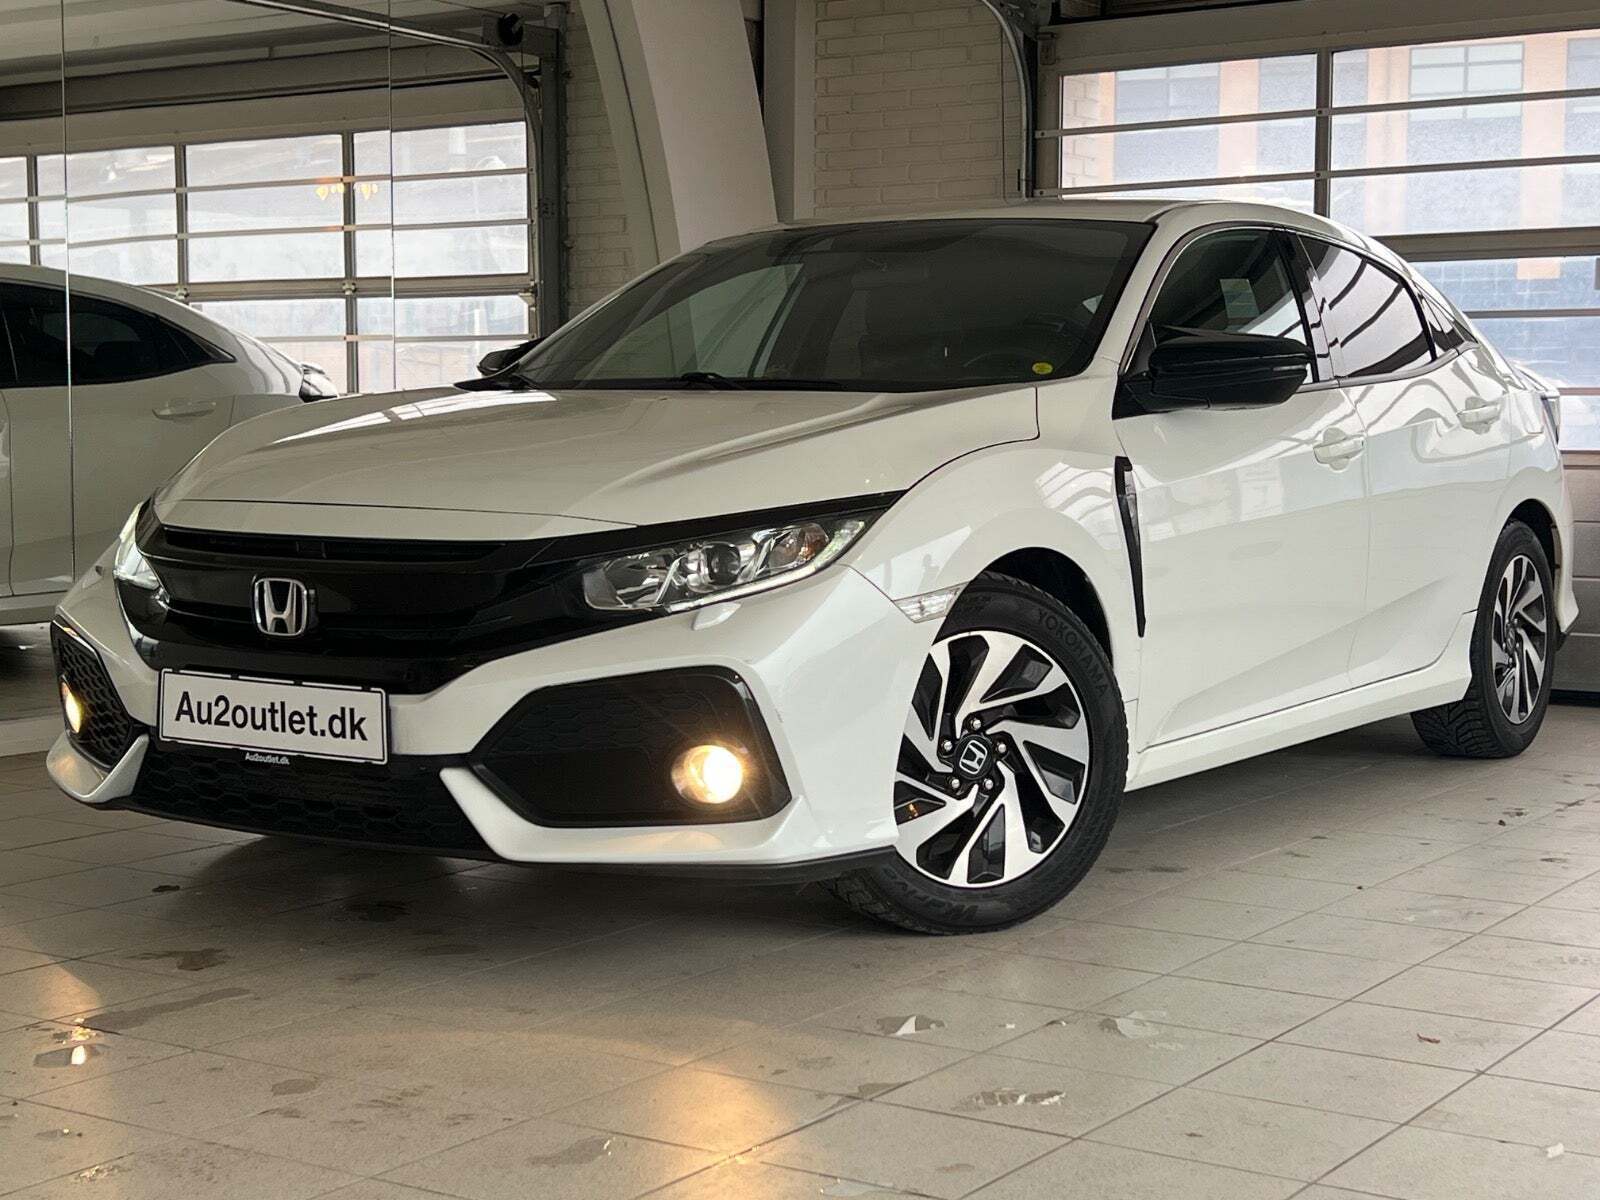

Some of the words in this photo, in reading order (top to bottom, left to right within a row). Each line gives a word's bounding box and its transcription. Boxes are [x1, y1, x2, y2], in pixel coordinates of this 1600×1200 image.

[1035, 606, 1109, 697] YOKOHAMA
[175, 691, 367, 741] Au2outlet.dk
[245, 752, 290, 765] Au2outlet.dk
